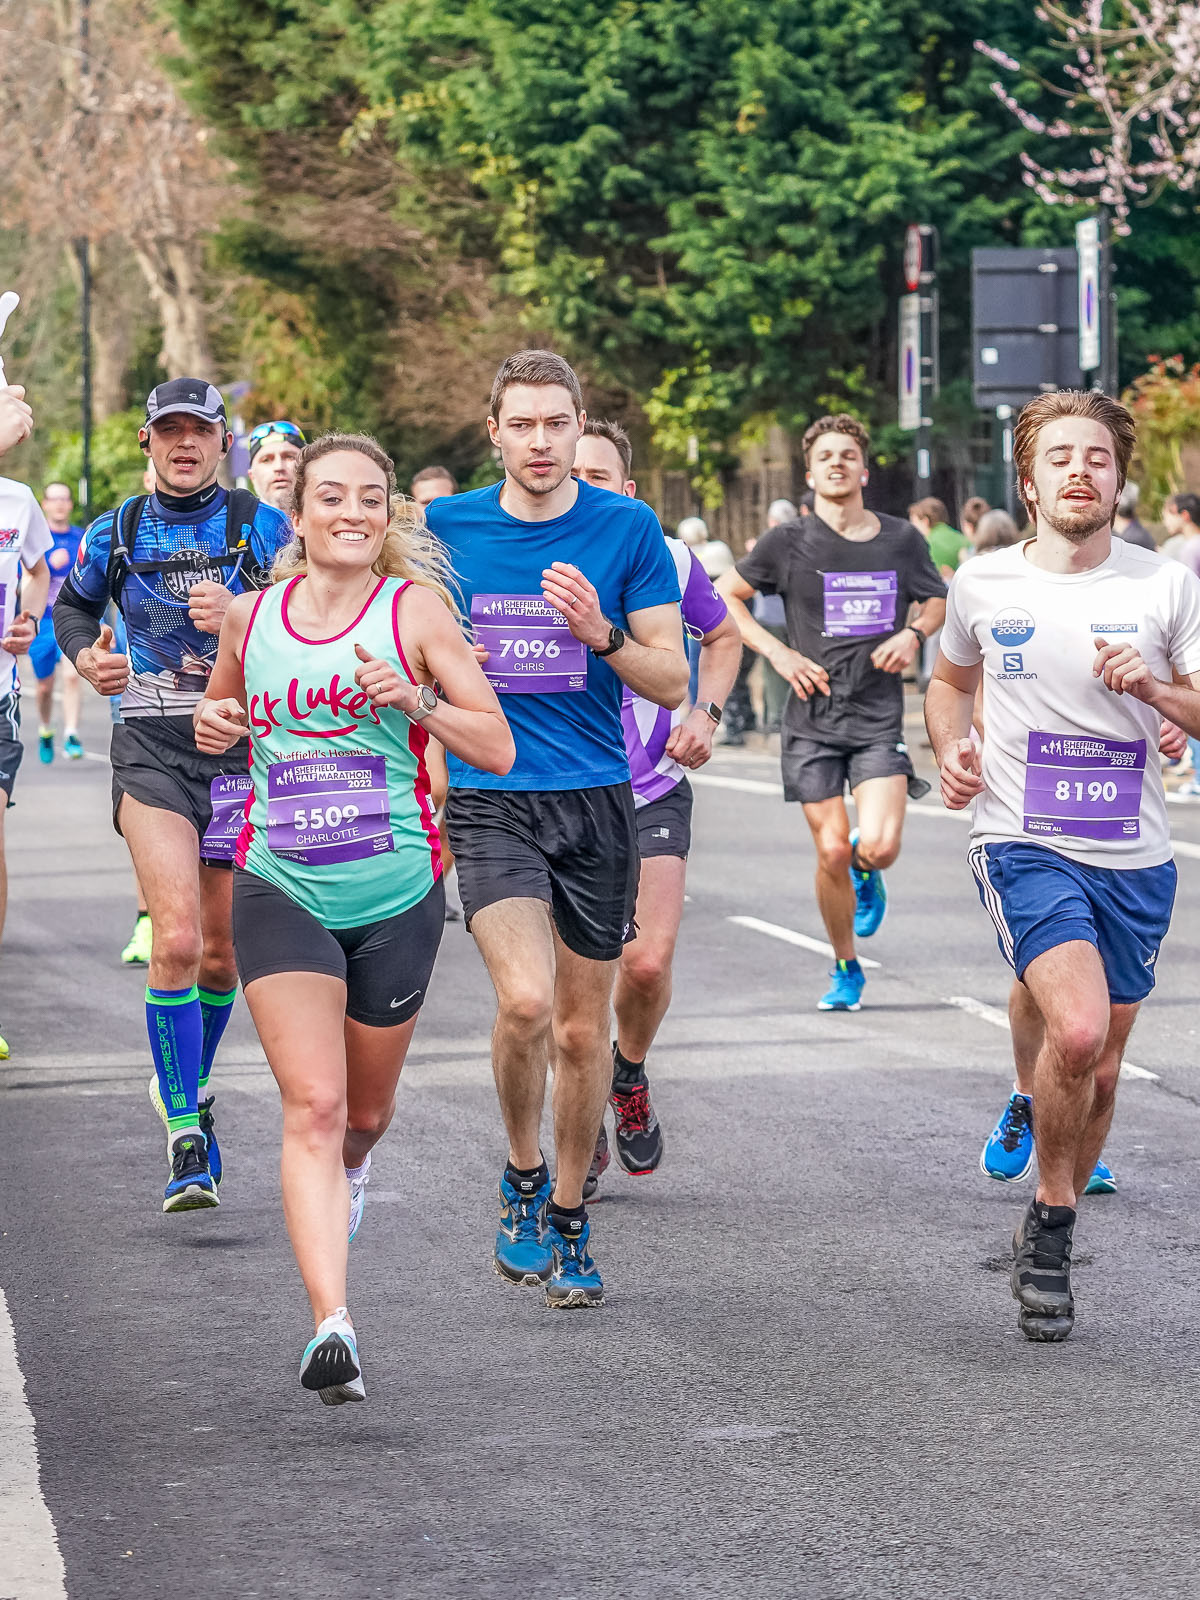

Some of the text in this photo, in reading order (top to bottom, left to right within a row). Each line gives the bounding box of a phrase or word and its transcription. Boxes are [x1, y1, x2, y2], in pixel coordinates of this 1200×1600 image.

[842, 600, 882, 614] 6372
[504, 608, 563, 616] HALF MARATH
[552, 617, 569, 625] 202
[995, 619, 1031, 627] SPORT
[997, 627, 1027, 635] 2000
[1092, 624, 1137, 632] ECOSPORT
[499, 639, 561, 658] 7096
[513, 662, 545, 671] CHRIS
[250, 674, 388, 738] St Lukes
[1064, 741, 1104, 750] SHEFFIELD
[273, 747, 372, 761] Sheffield's Hospice
[1086, 749, 1136, 759] MARATHON
[1110, 759, 1135, 767] 2022
[295, 764, 336, 774] SHEFFIELD
[296, 770, 371, 783] HALF MARATHON
[348, 780, 372, 788] 2022
[1055, 780, 1118, 802] 8190
[294, 804, 360, 830] 5509
[268, 819, 277, 827] M
[296, 827, 360, 845] CHARLOTTE
